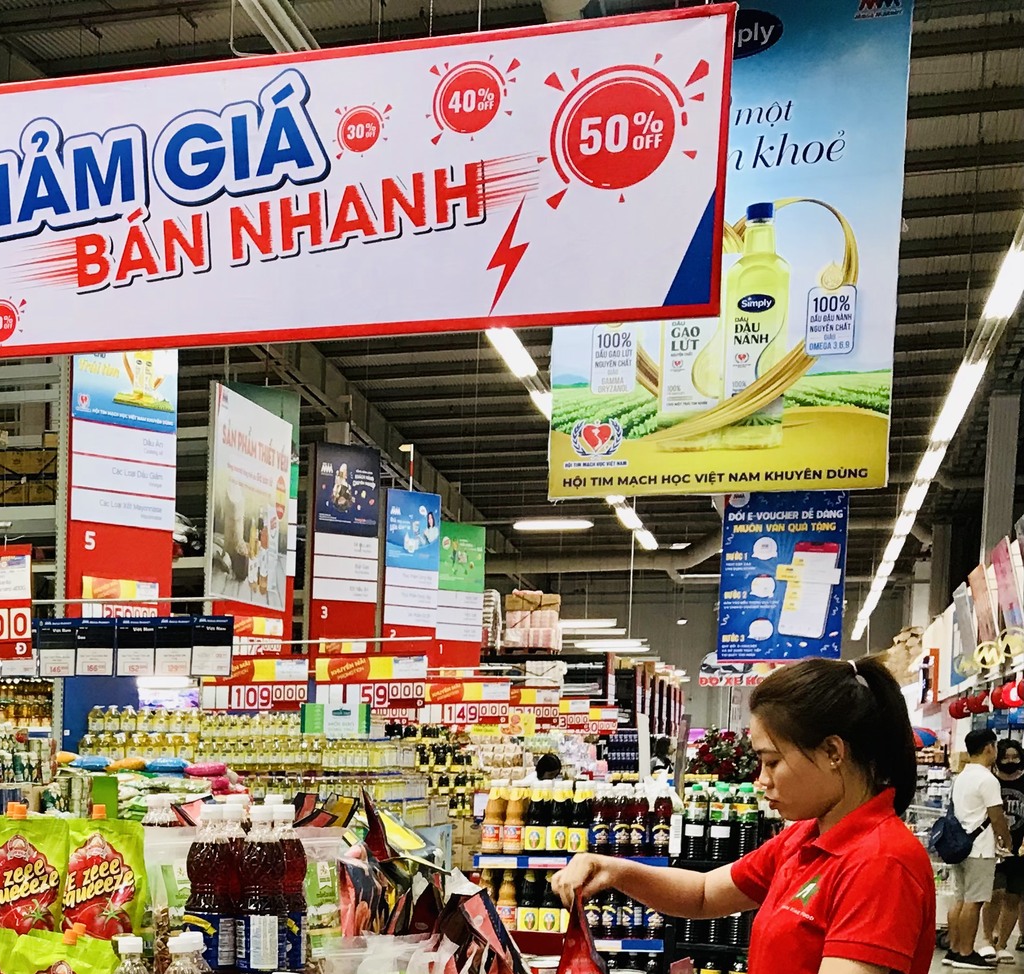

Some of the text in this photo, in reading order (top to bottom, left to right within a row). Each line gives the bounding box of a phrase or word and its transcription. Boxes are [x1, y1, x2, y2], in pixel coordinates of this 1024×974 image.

[478, 102, 494, 112] OFF
[735, 100, 794, 128] một
[163, 83, 315, 190] GIÁ
[579, 111, 663, 155] 50%
[632, 134, 662, 152] OFF
[76, 161, 484, 294] BÁN NHANH
[741, 297, 772, 308] Simply
[813, 295, 850, 313] 100%
[598, 332, 631, 348] 100%
[563, 467, 868, 489] HỘI TIM MẠCH HỌC VIỆT NAM KHUYÊN DÙNG
[748, 510, 799, 521] E-VOUCHER
[84, 531, 96, 550] 5
[321, 605, 328, 619] 3
[390, 629, 396, 638] 2
[4, 859, 46, 884] zeee
